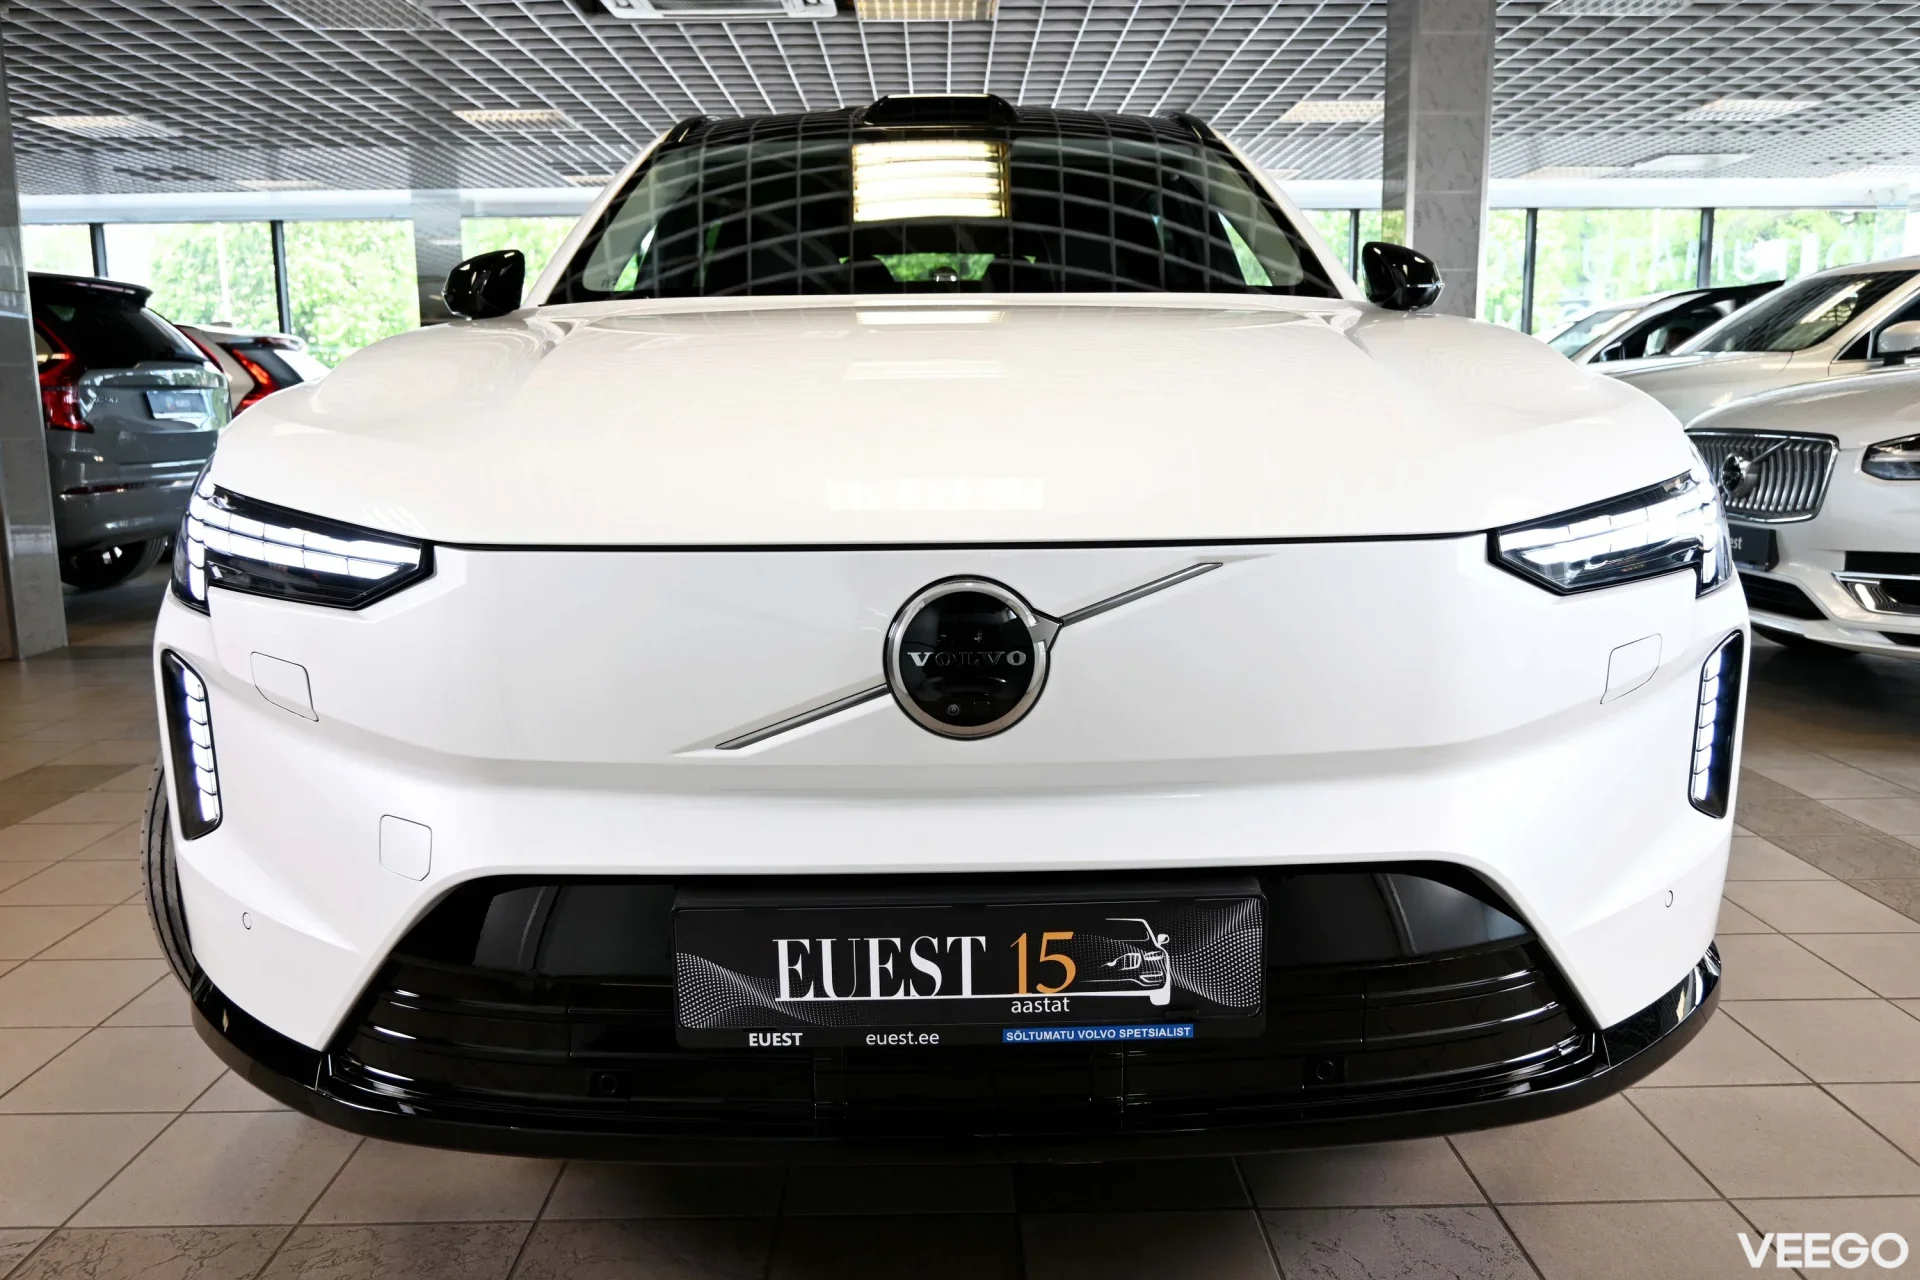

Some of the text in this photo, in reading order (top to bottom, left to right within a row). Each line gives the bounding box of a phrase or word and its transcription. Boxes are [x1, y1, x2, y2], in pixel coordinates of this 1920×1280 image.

[907, 651, 1027, 666] VOLVO
[772, 931, 1077, 999] EUEST 15
[1011, 997, 1070, 1013] aastat
[749, 1032, 803, 1046] EUEST
[866, 1031, 939, 1045] euest.ee
[1006, 1026, 1191, 1041] SÕLTUMATU VOLVO SPETSIALIST
